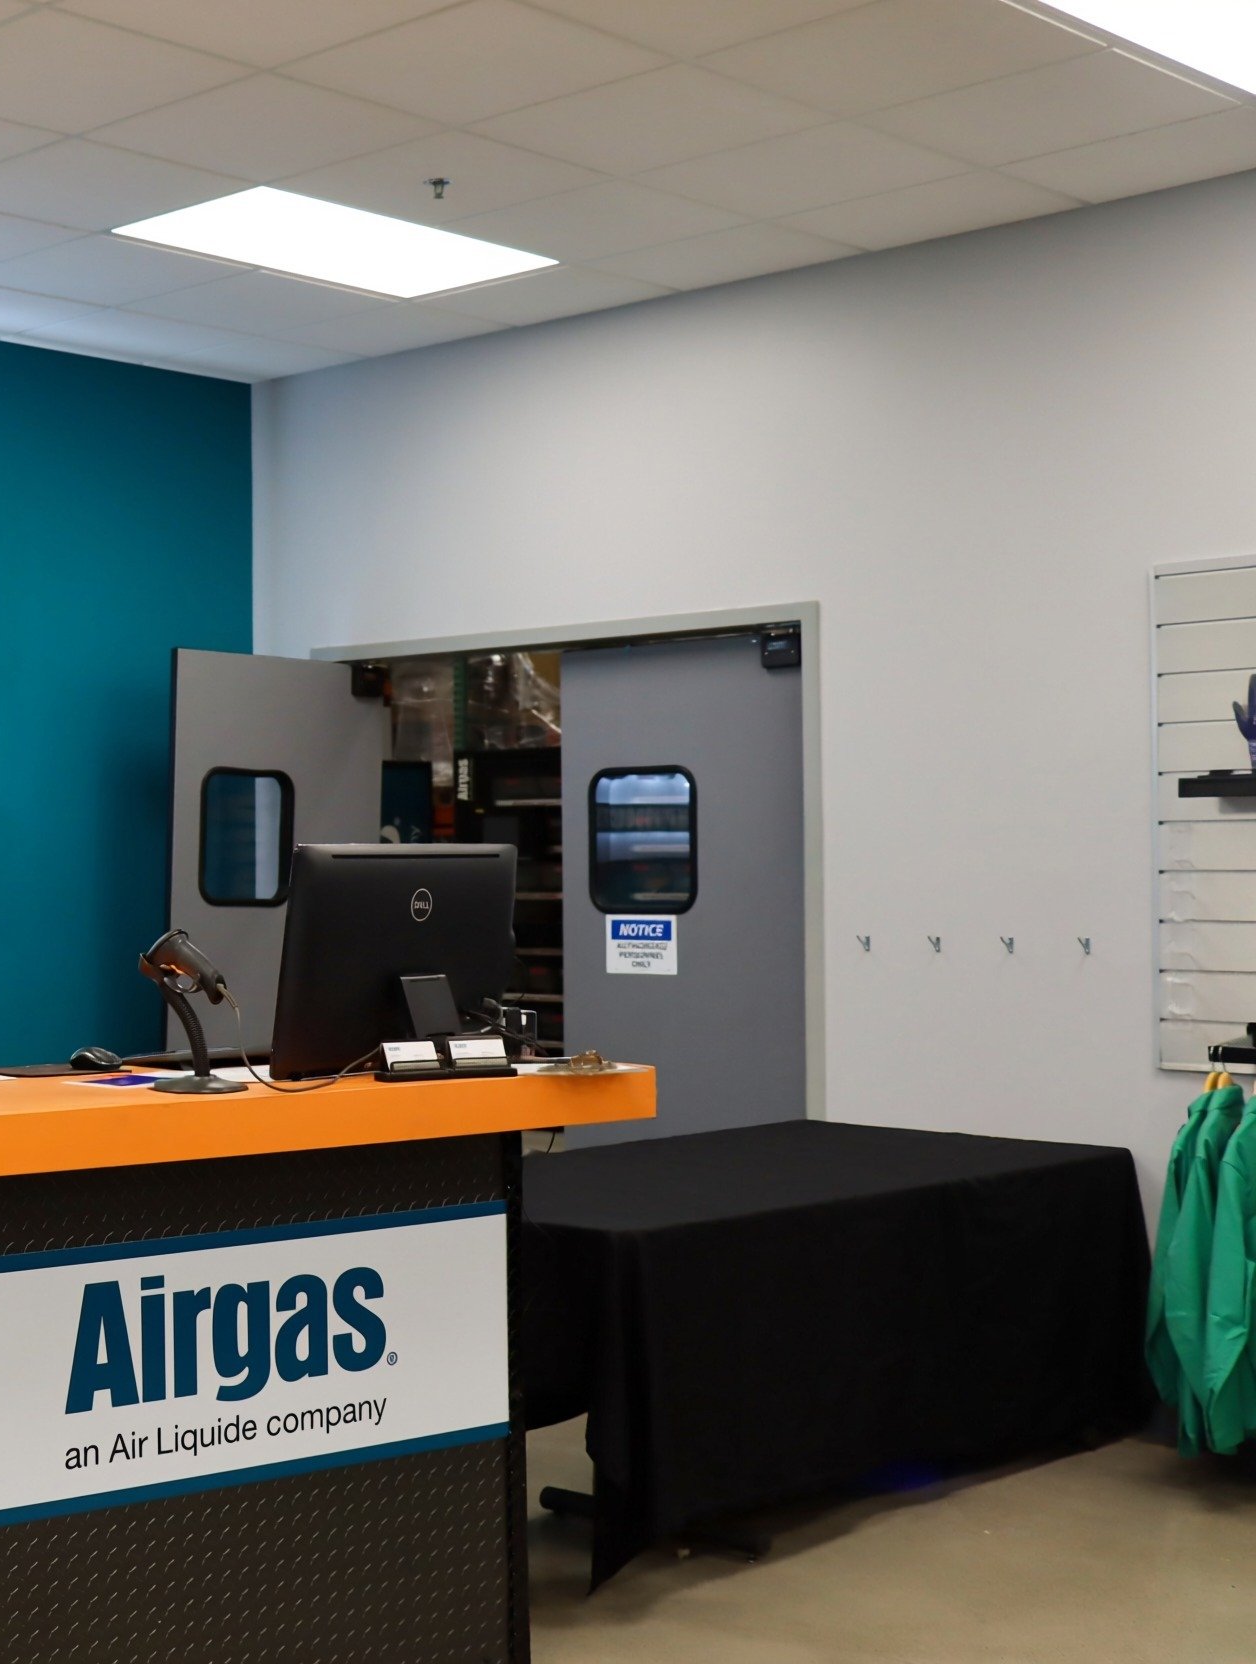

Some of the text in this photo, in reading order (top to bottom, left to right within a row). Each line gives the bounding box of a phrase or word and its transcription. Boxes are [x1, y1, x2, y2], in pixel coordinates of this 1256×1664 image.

[619, 923, 664, 937] NOTICE
[64, 1266, 386, 1414] Airgas
[65, 1397, 387, 1470] an Air Liquide company
